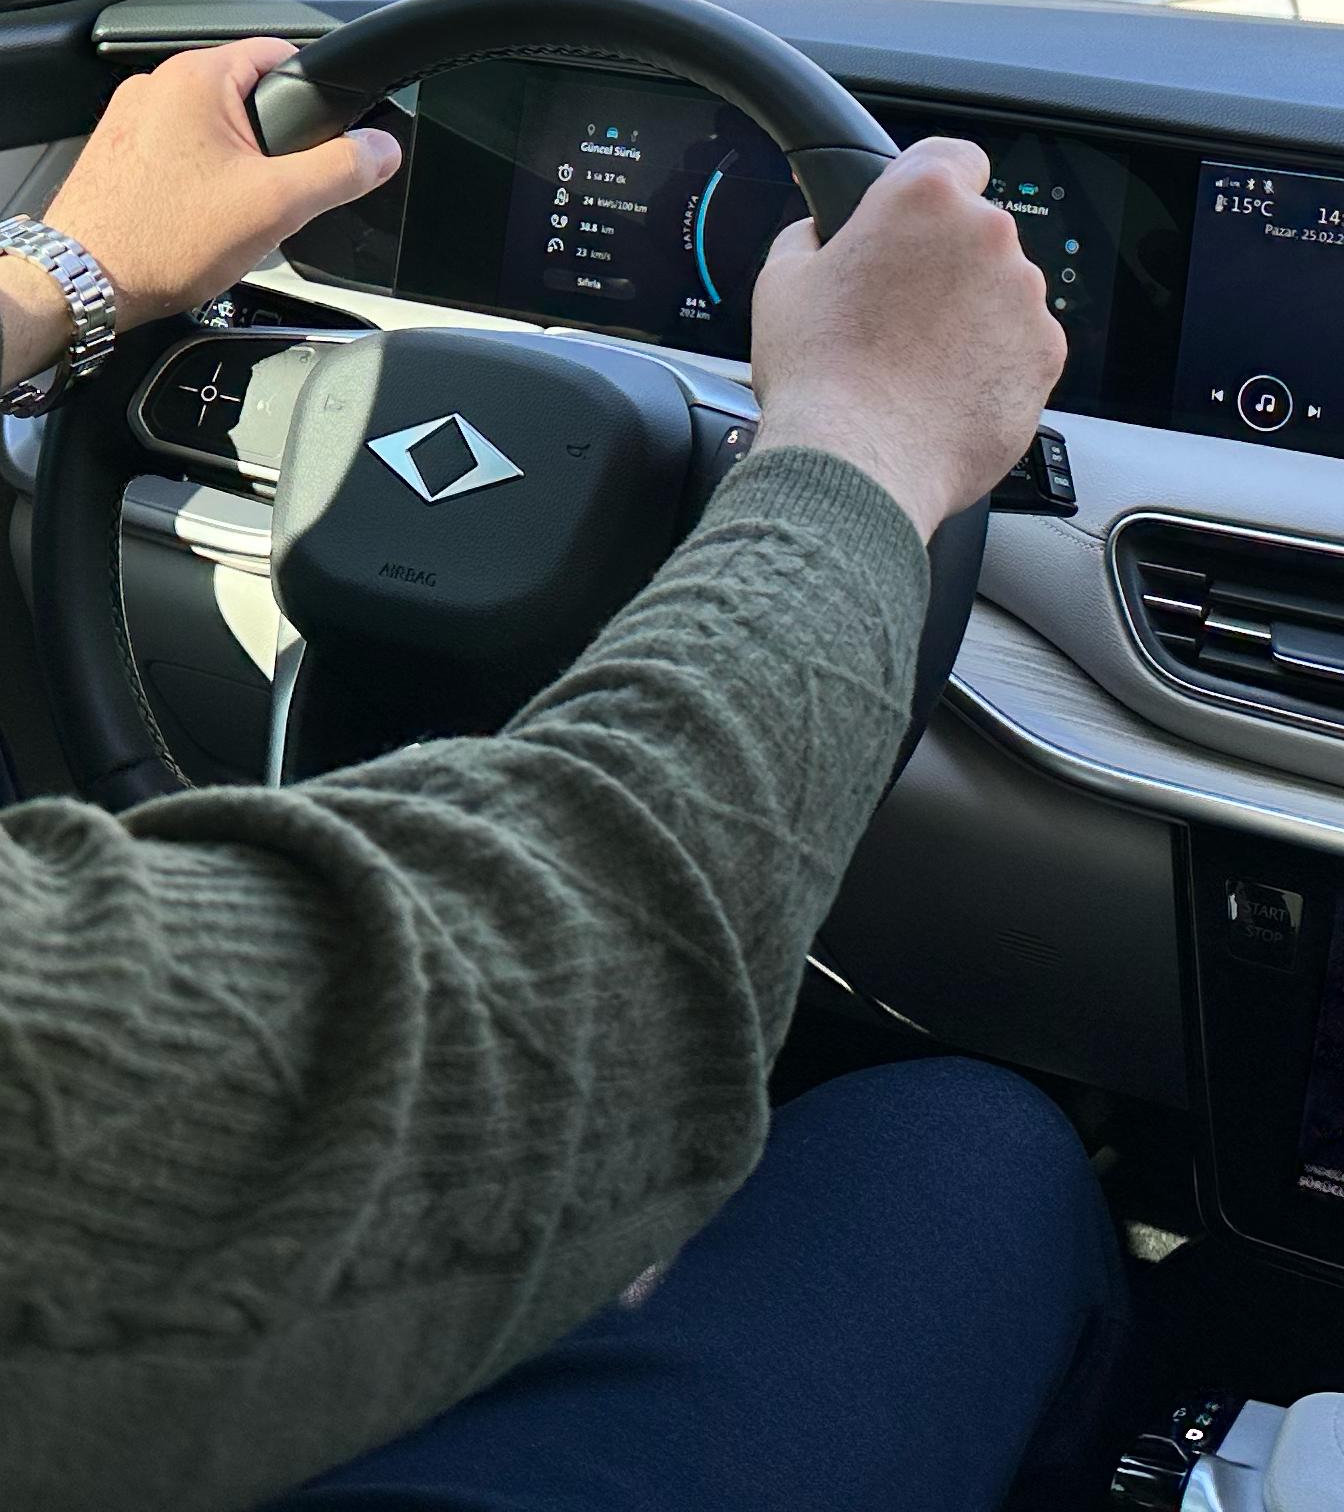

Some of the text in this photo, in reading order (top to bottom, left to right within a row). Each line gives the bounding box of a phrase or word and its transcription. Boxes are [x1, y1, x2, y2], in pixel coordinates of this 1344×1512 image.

[604, 172, 615, 183] 37
[634, 202, 647, 213] km
[683, 195, 699, 250] BATARYA
[601, 224, 615, 235] km
[576, 247, 587, 257] 23
[696, 309, 711, 320] km
[378, 562, 437, 587] AIRBAG
